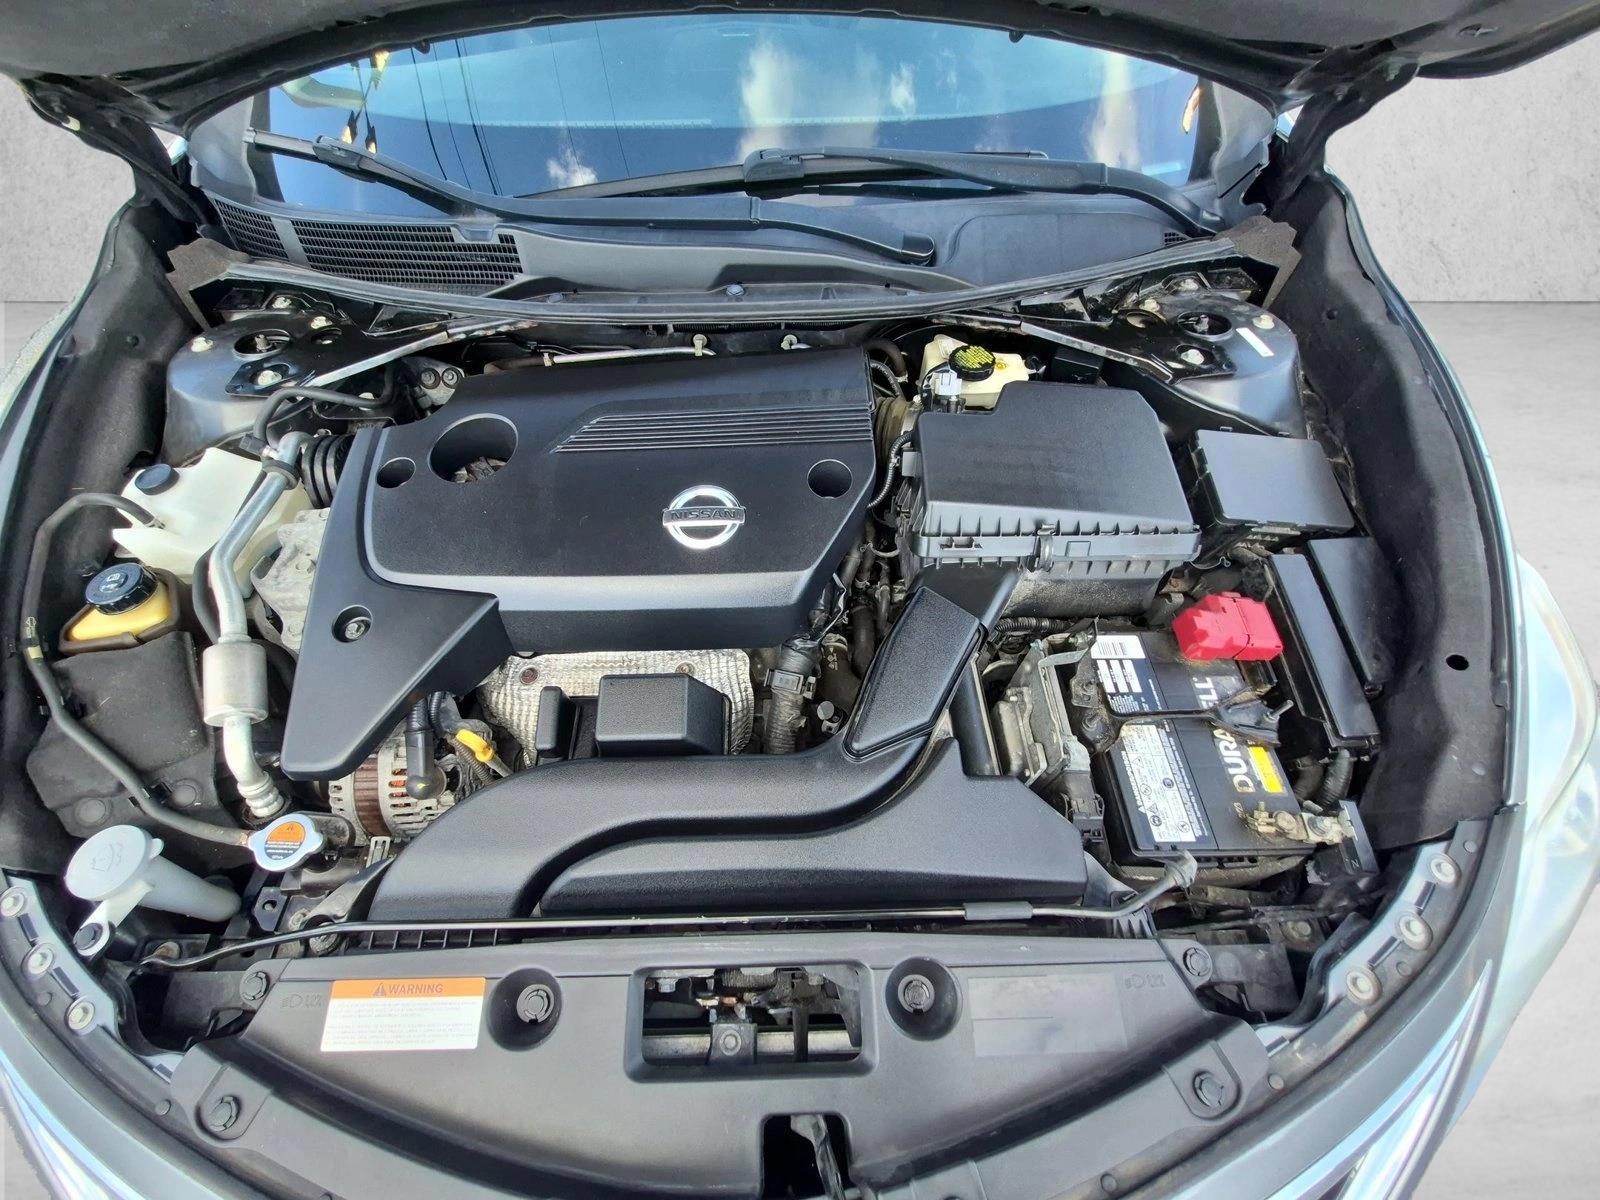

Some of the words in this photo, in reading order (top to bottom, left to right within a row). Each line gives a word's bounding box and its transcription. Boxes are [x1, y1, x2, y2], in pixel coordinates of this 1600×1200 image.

[670, 508, 736, 520] NISSAN
[1192, 676, 1256, 793] DURAELL
[388, 983, 443, 995] WARNING
